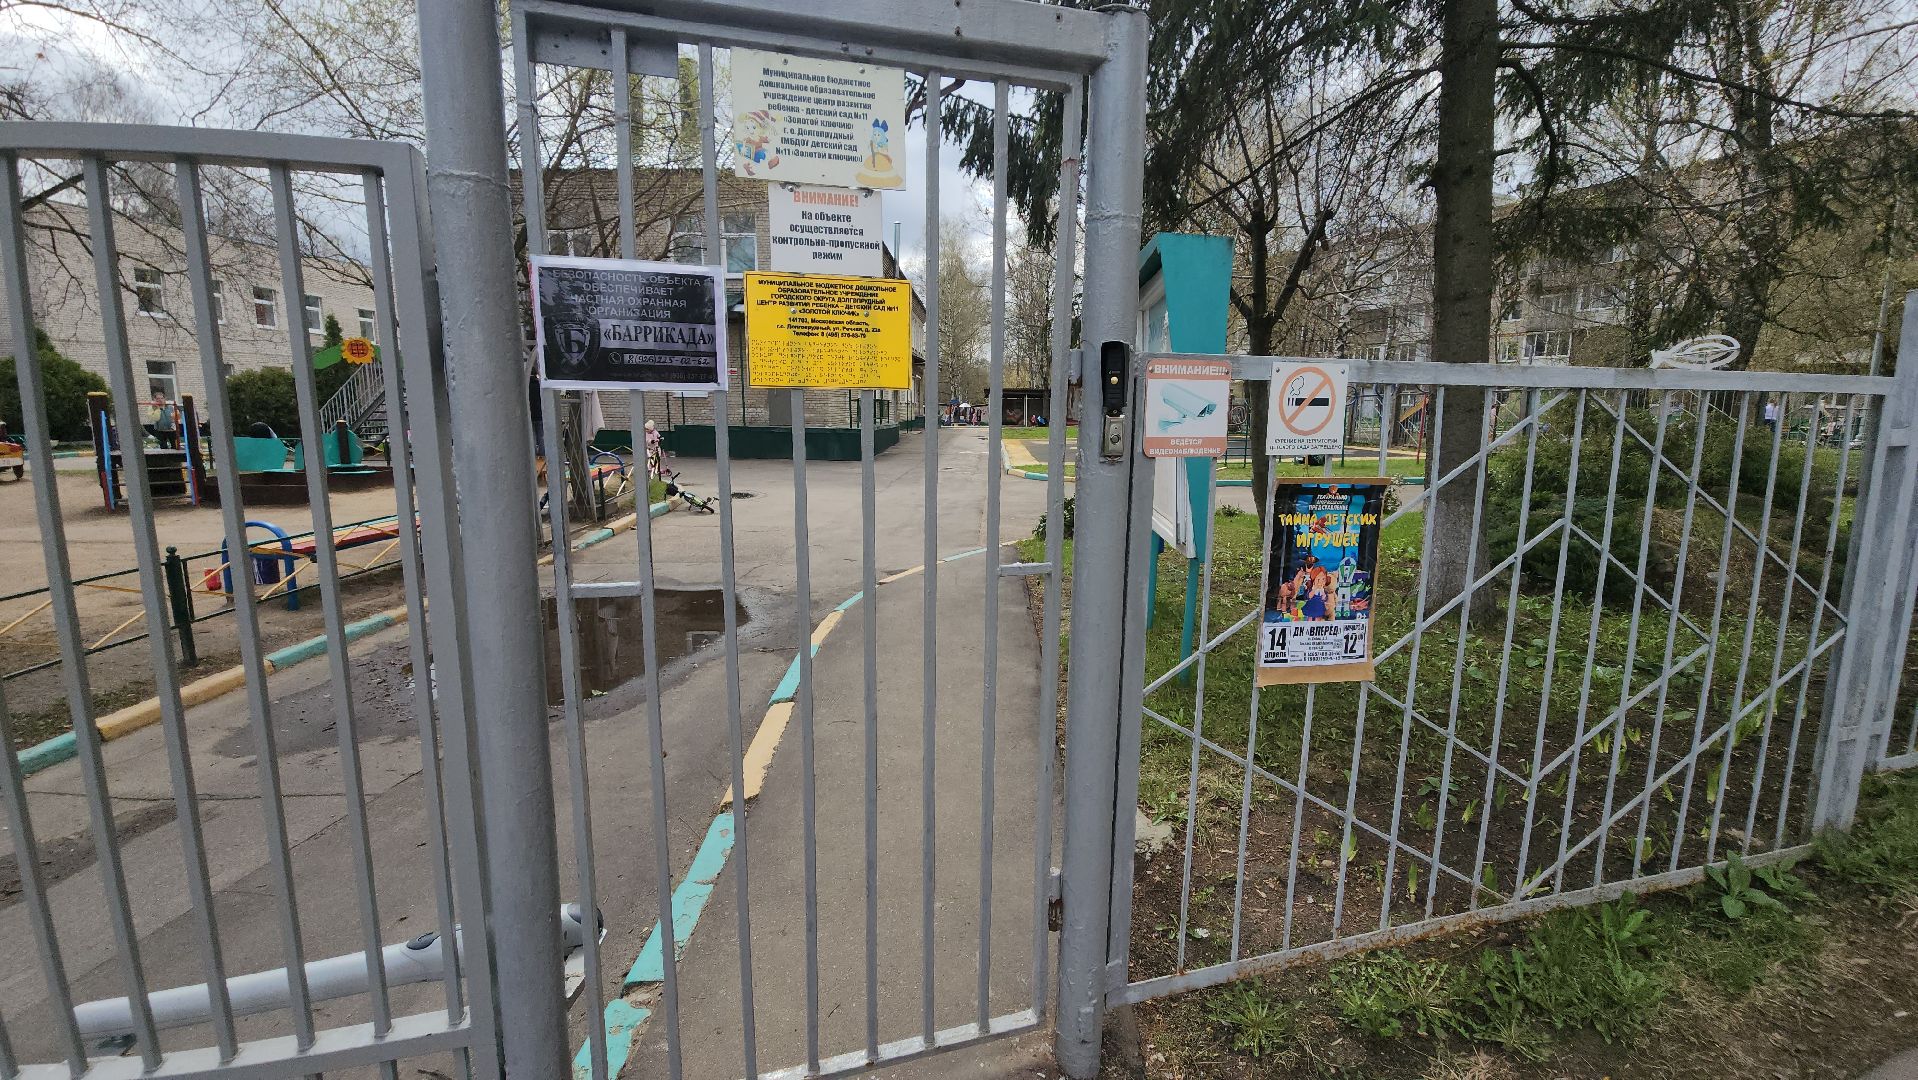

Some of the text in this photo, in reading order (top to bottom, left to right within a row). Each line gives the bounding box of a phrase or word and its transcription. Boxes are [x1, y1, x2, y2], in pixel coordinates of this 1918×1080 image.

[763, 67, 871, 88] Муниципальное бюджетное
[759, 80, 876, 99] дошкольное образовательное
[763, 92, 872, 110] учреждение центр развития
[806, 107, 838, 117] детский
[854, 112, 868, 120] №11
[797, 128, 854, 140] Долгопрудный
[776, 147, 791, 156] №11
[811, 140, 843, 150] детский
[844, 144, 858, 152] сад
[793, 190, 859, 207] ВНИМАНИЕ!
[802, 211, 852, 223] На объекте
[790, 223, 864, 236] осуществляется
[772, 236, 880, 250] контрольно-пропускной
[812, 251, 843, 260] режим
[552, 269, 701, 287] БЕЗОПАСНОСТЬ ОБЪЕКТА
[583, 283, 674, 296] ОБЕСПЕЧИВАЕТ
[758, 279, 897, 293] МУНИЦИПАЛЬНОЕ БЮДЖЕТНОЕ ДОШКОЛЬНОЕ
[777, 287, 879, 298] ОБРАЗОВАТЕЛЬНОЕ УЧРЕЖДЕНИЕ
[570, 293, 687, 308] ЧАСТНАЯ ОХРАННАЯ
[771, 293, 886, 305] ГОРОДСКОГО ОКРУГА ДОЛГОПРУДНЫЙ
[779, 300, 811, 308] РАЗВИТИЯ
[845, 303, 872, 311] ДЕТСКИЙ
[588, 306, 671, 319] ОРГАНИЗАЦИЯ
[603, 323, 714, 348] «БАРРИКАДА»
[1154, 364, 1226, 375] ВНИМАНИЕ!!!
[1149, 447, 1221, 455] ВИДЕОНАБЛЮДЕНИЕ
[1278, 511, 1378, 526] ТАЙНА ДЕТСКИХ
[1296, 532, 1360, 548] ИГРУШЕК
[1268, 628, 1287, 651] 14
[1293, 626, 1305, 638] ДК
[1344, 633, 1357, 654] 12
